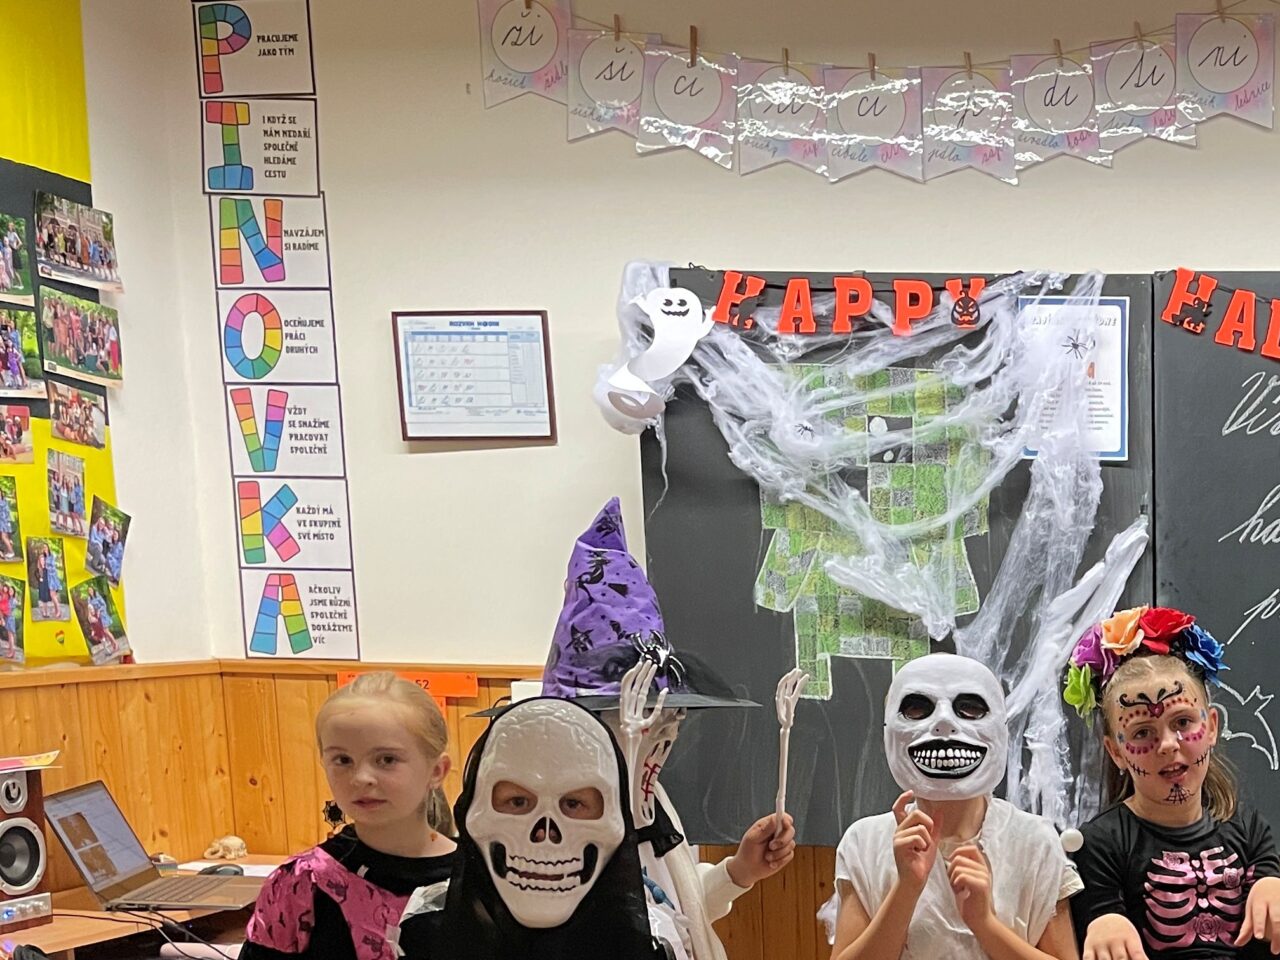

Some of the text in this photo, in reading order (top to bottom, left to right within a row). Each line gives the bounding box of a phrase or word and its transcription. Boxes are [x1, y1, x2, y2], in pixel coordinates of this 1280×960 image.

[256, 33, 299, 43] PRACUJEME
[258, 45, 295, 56] JAKO TÝM
[267, 113, 287, 124] KDYŽ
[288, 116, 297, 124] SE
[263, 127, 280, 138] NÁM
[263, 140, 299, 152] SPOLEČNĚ
[263, 154, 297, 165] HLEDÁME
[264, 170, 287, 178] CESTU
[283, 226, 325, 237] NAVZÁJEM
[284, 240, 320, 251] SI RADÍME
[712, 270, 987, 337] HAPPY
[283, 316, 325, 328] OCEŇUJEME
[284, 330, 306, 341] PRÁCI
[285, 343, 319, 354] DRUHÝCH
[287, 405, 307, 415] VŽDY
[288, 418, 330, 428] SE SNAŽÍME
[288, 433, 328, 442] PRACOVAT
[290, 443, 328, 454] SPOLEČNĚ
[296, 504, 334, 515] KAŽDÝ MÁ
[296, 518, 342, 528] VE SKUPINĚ
[312, 530, 335, 540] MÍSTO
[308, 584, 342, 594] AČKOLIV
[309, 598, 328, 607] JSME
[310, 609, 348, 619] SPOLEČNĚ
[311, 622, 353, 632] DOKÁŽEME
[312, 634, 326, 644] VÍC
